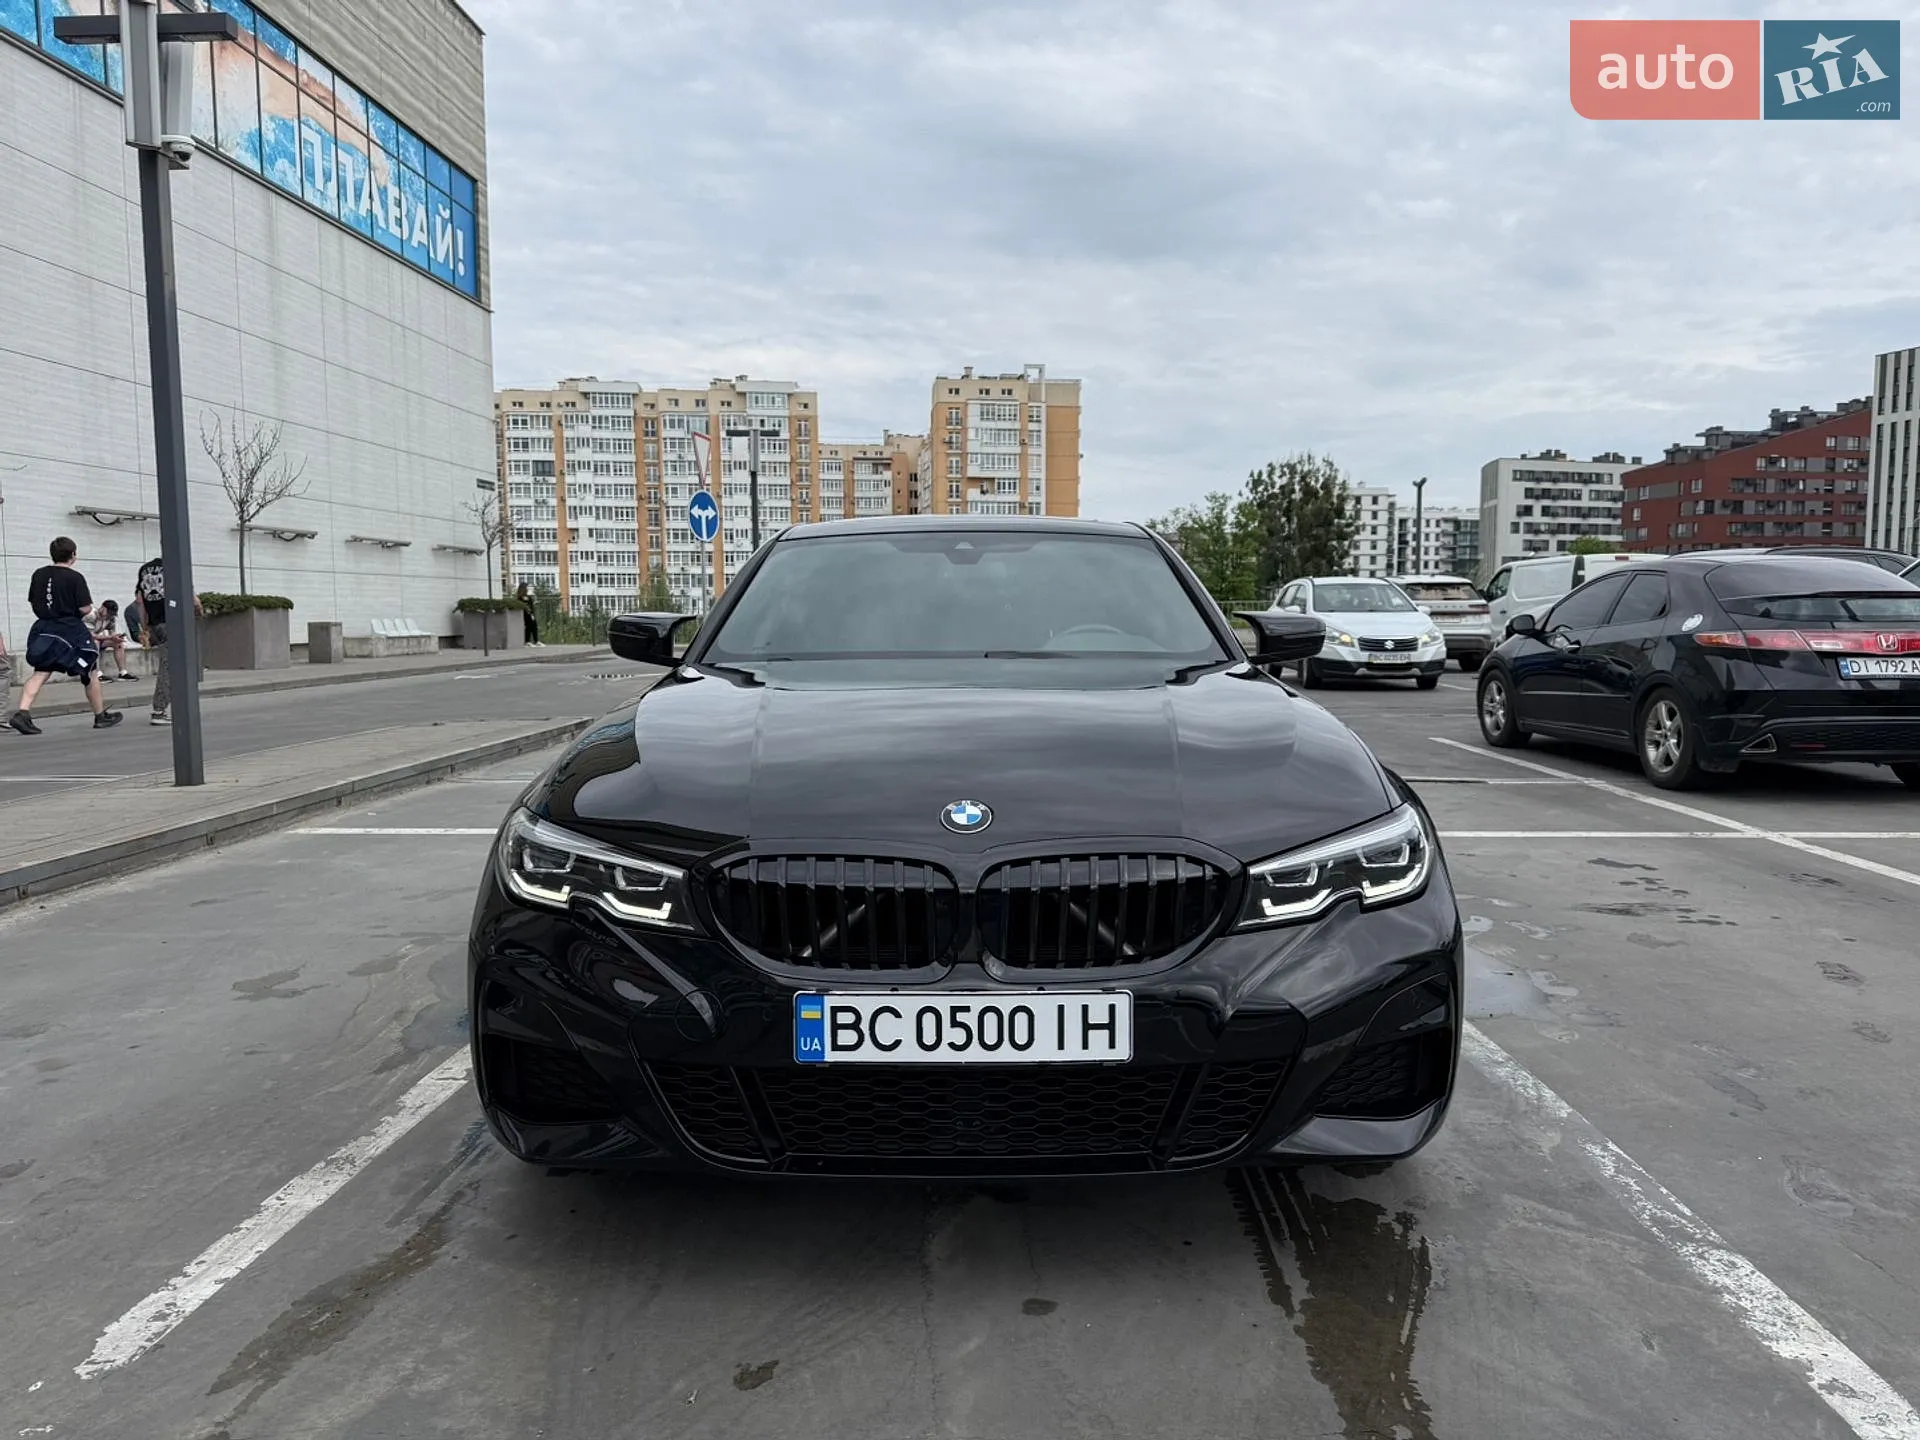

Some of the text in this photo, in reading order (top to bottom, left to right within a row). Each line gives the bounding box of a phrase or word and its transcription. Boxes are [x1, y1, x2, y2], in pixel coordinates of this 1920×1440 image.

[293, 117, 465, 277] ПЛАВАЙ!
[1849, 660, 1870, 673] DI
[1875, 660, 1908, 673] 1792
[829, 1003, 1117, 1051] BC 0500 IH
[801, 1036, 822, 1051] UA
